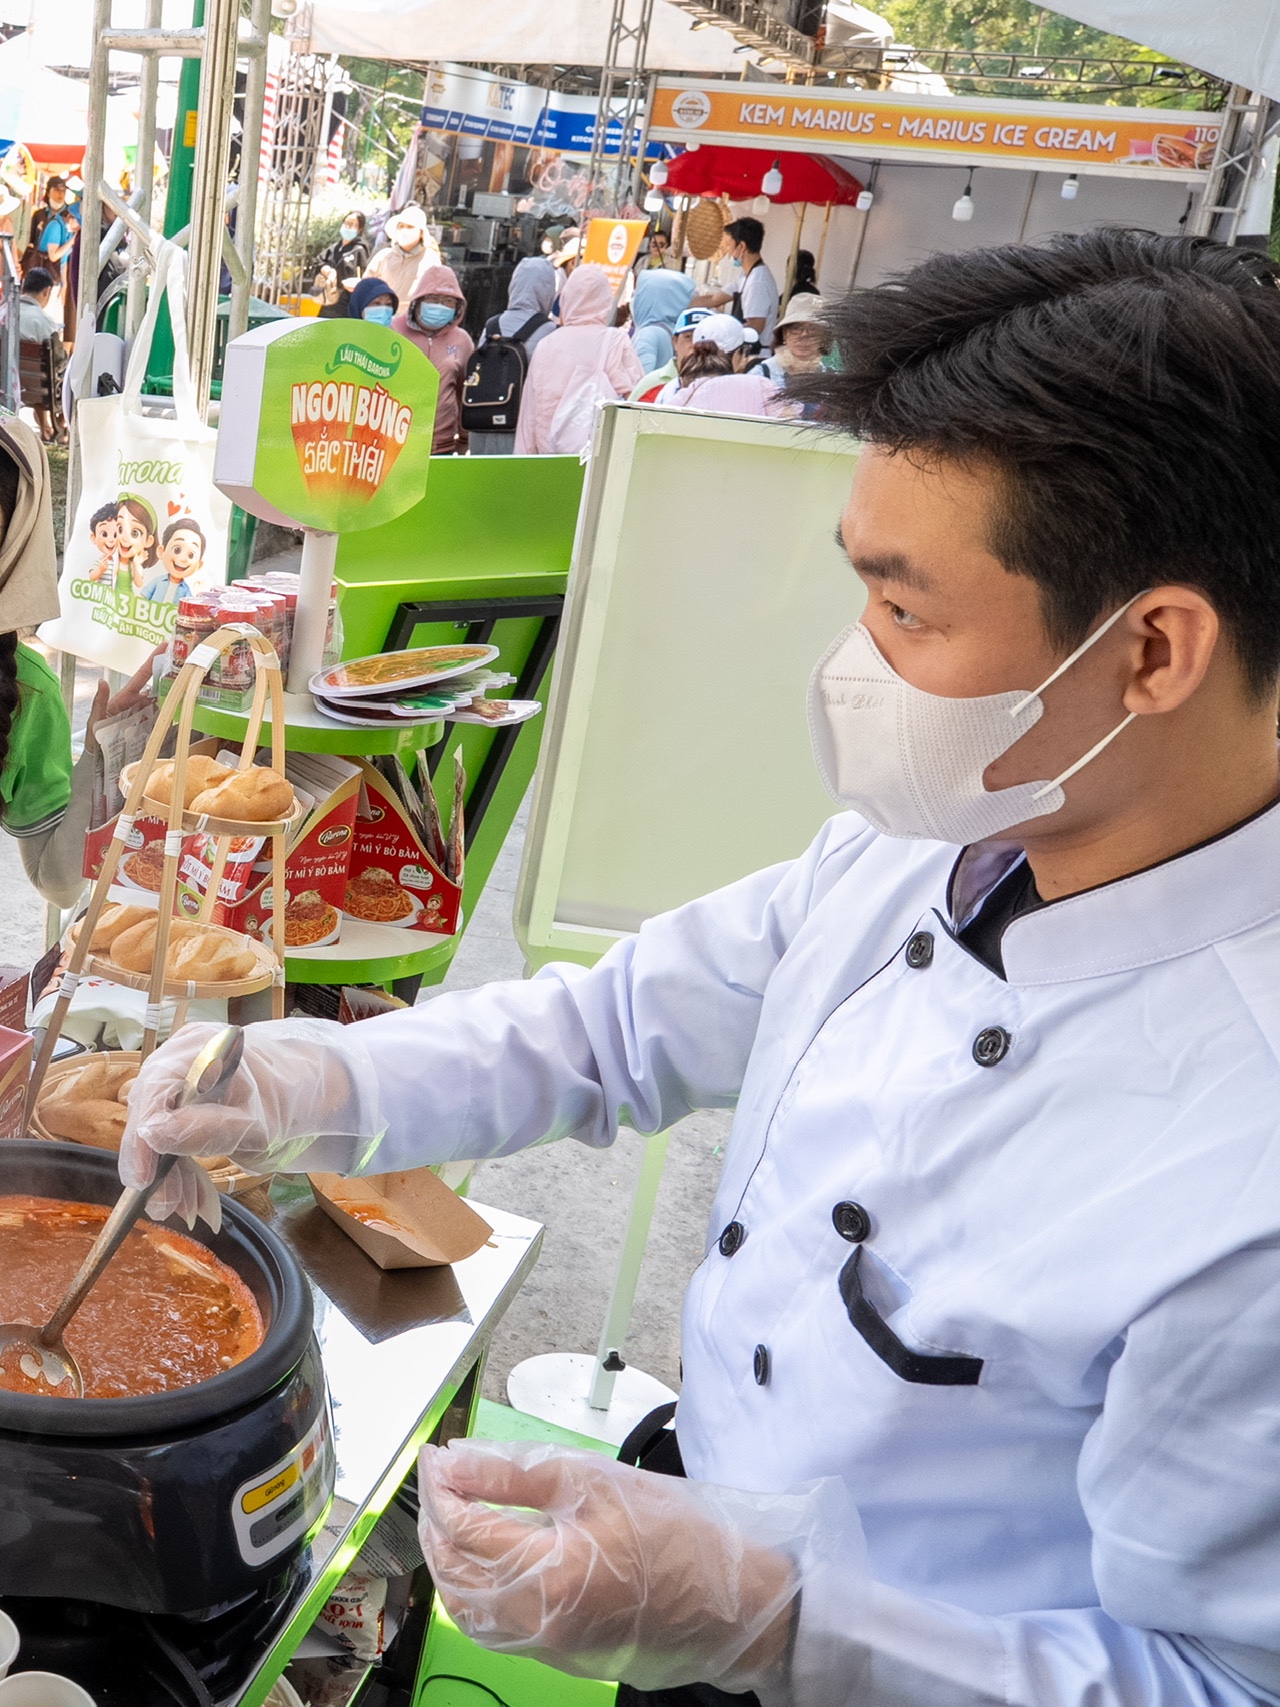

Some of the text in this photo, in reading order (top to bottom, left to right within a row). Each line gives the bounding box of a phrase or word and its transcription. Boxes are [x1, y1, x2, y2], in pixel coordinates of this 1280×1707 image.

[739, 103, 785, 126] KEM
[791, 107, 875, 133] MARIUS
[898, 116, 987, 143] MARIUS
[992, 124, 1028, 146] ICE
[1034, 127, 1117, 152] CREAM
[1194, 126, 1219, 143] 110
[367, 358, 390, 377] BARONA
[292, 382, 413, 444] NGON BỪNG
[343, 439, 385, 485] THÁI
[118, 458, 185, 485] arona
[119, 597, 129, 615] 3
[321, 828, 348, 843] Barona
[360, 841, 373, 854] MÌ
[375, 842, 382, 855] Ý
[384, 845, 396, 857] BÒ
[294, 866, 306, 878] MÌ
[308, 864, 314, 877] Ý
[315, 863, 327, 876] BÒ
